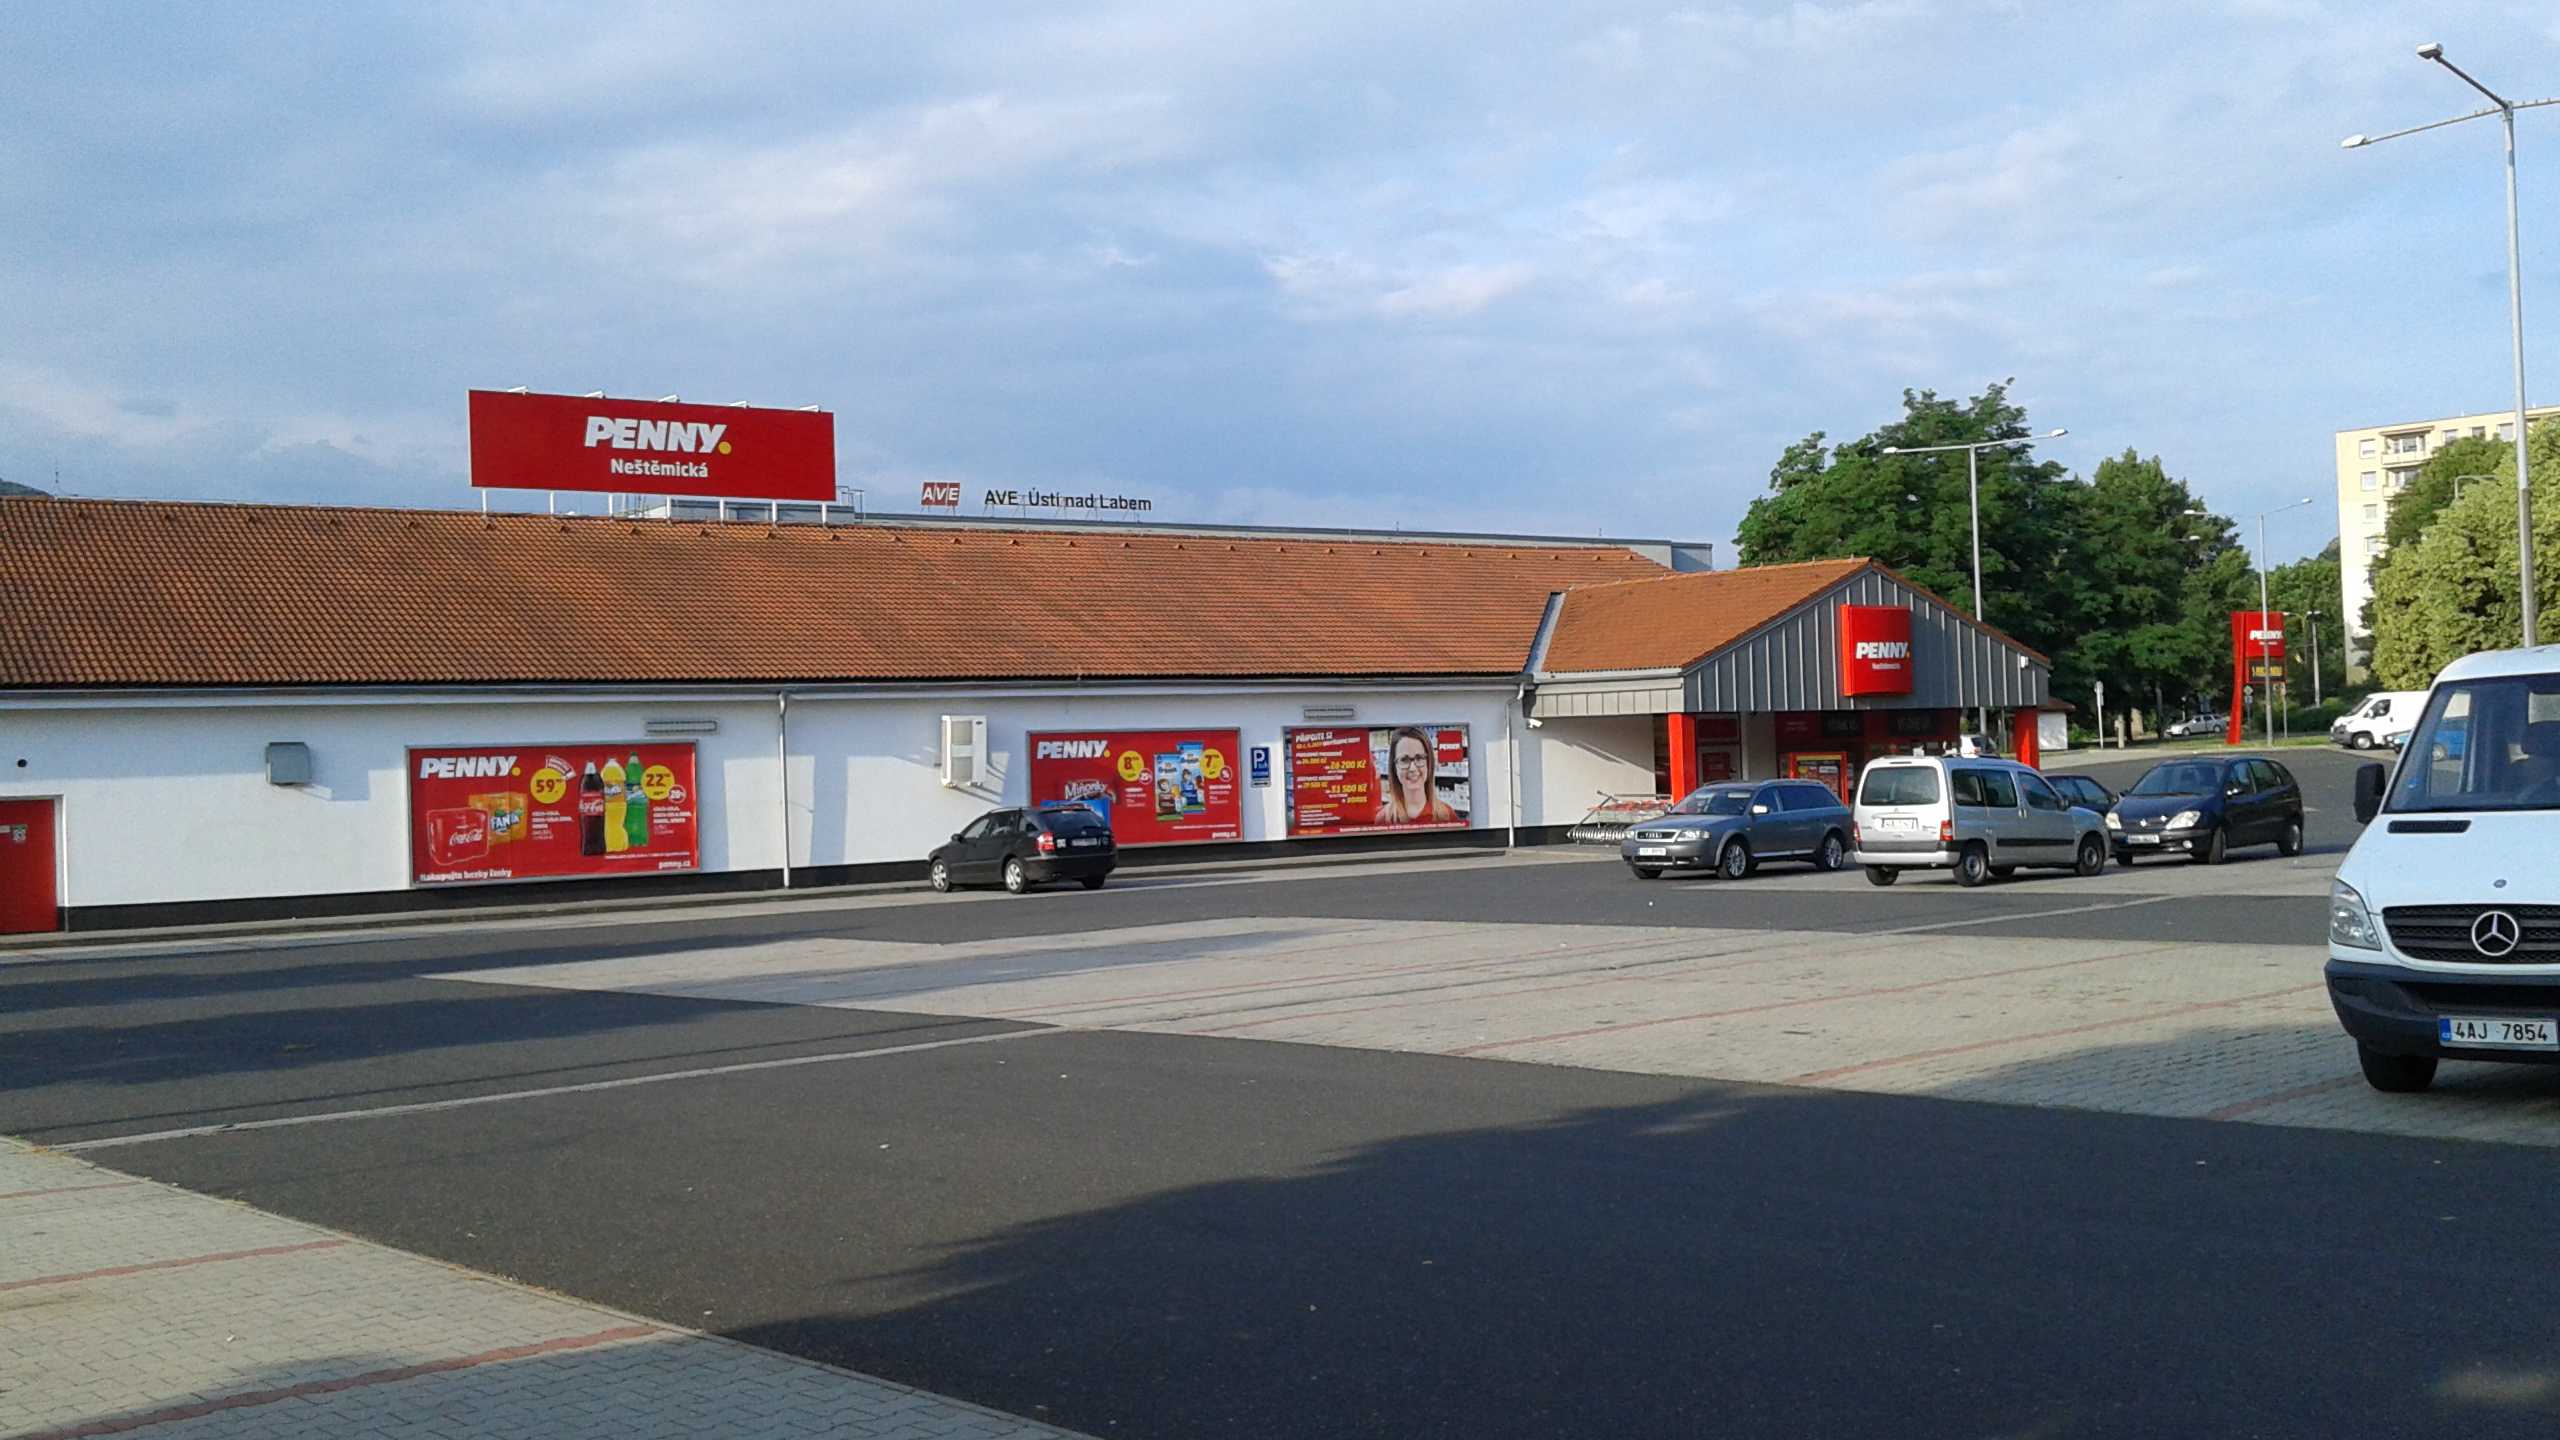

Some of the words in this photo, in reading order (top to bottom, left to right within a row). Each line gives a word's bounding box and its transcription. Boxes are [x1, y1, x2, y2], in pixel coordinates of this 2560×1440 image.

[611, 458, 708, 478] Neštěmická
[922, 487, 959, 502] AVE
[984, 490, 1018, 506] AVE
[1028, 487, 1060, 507] Ústí
[1065, 493, 1094, 508] nad
[1100, 494, 1151, 511] Labem
[2454, 1022, 2487, 1039] 4AJ
[2501, 1023, 2547, 1042] 7854
